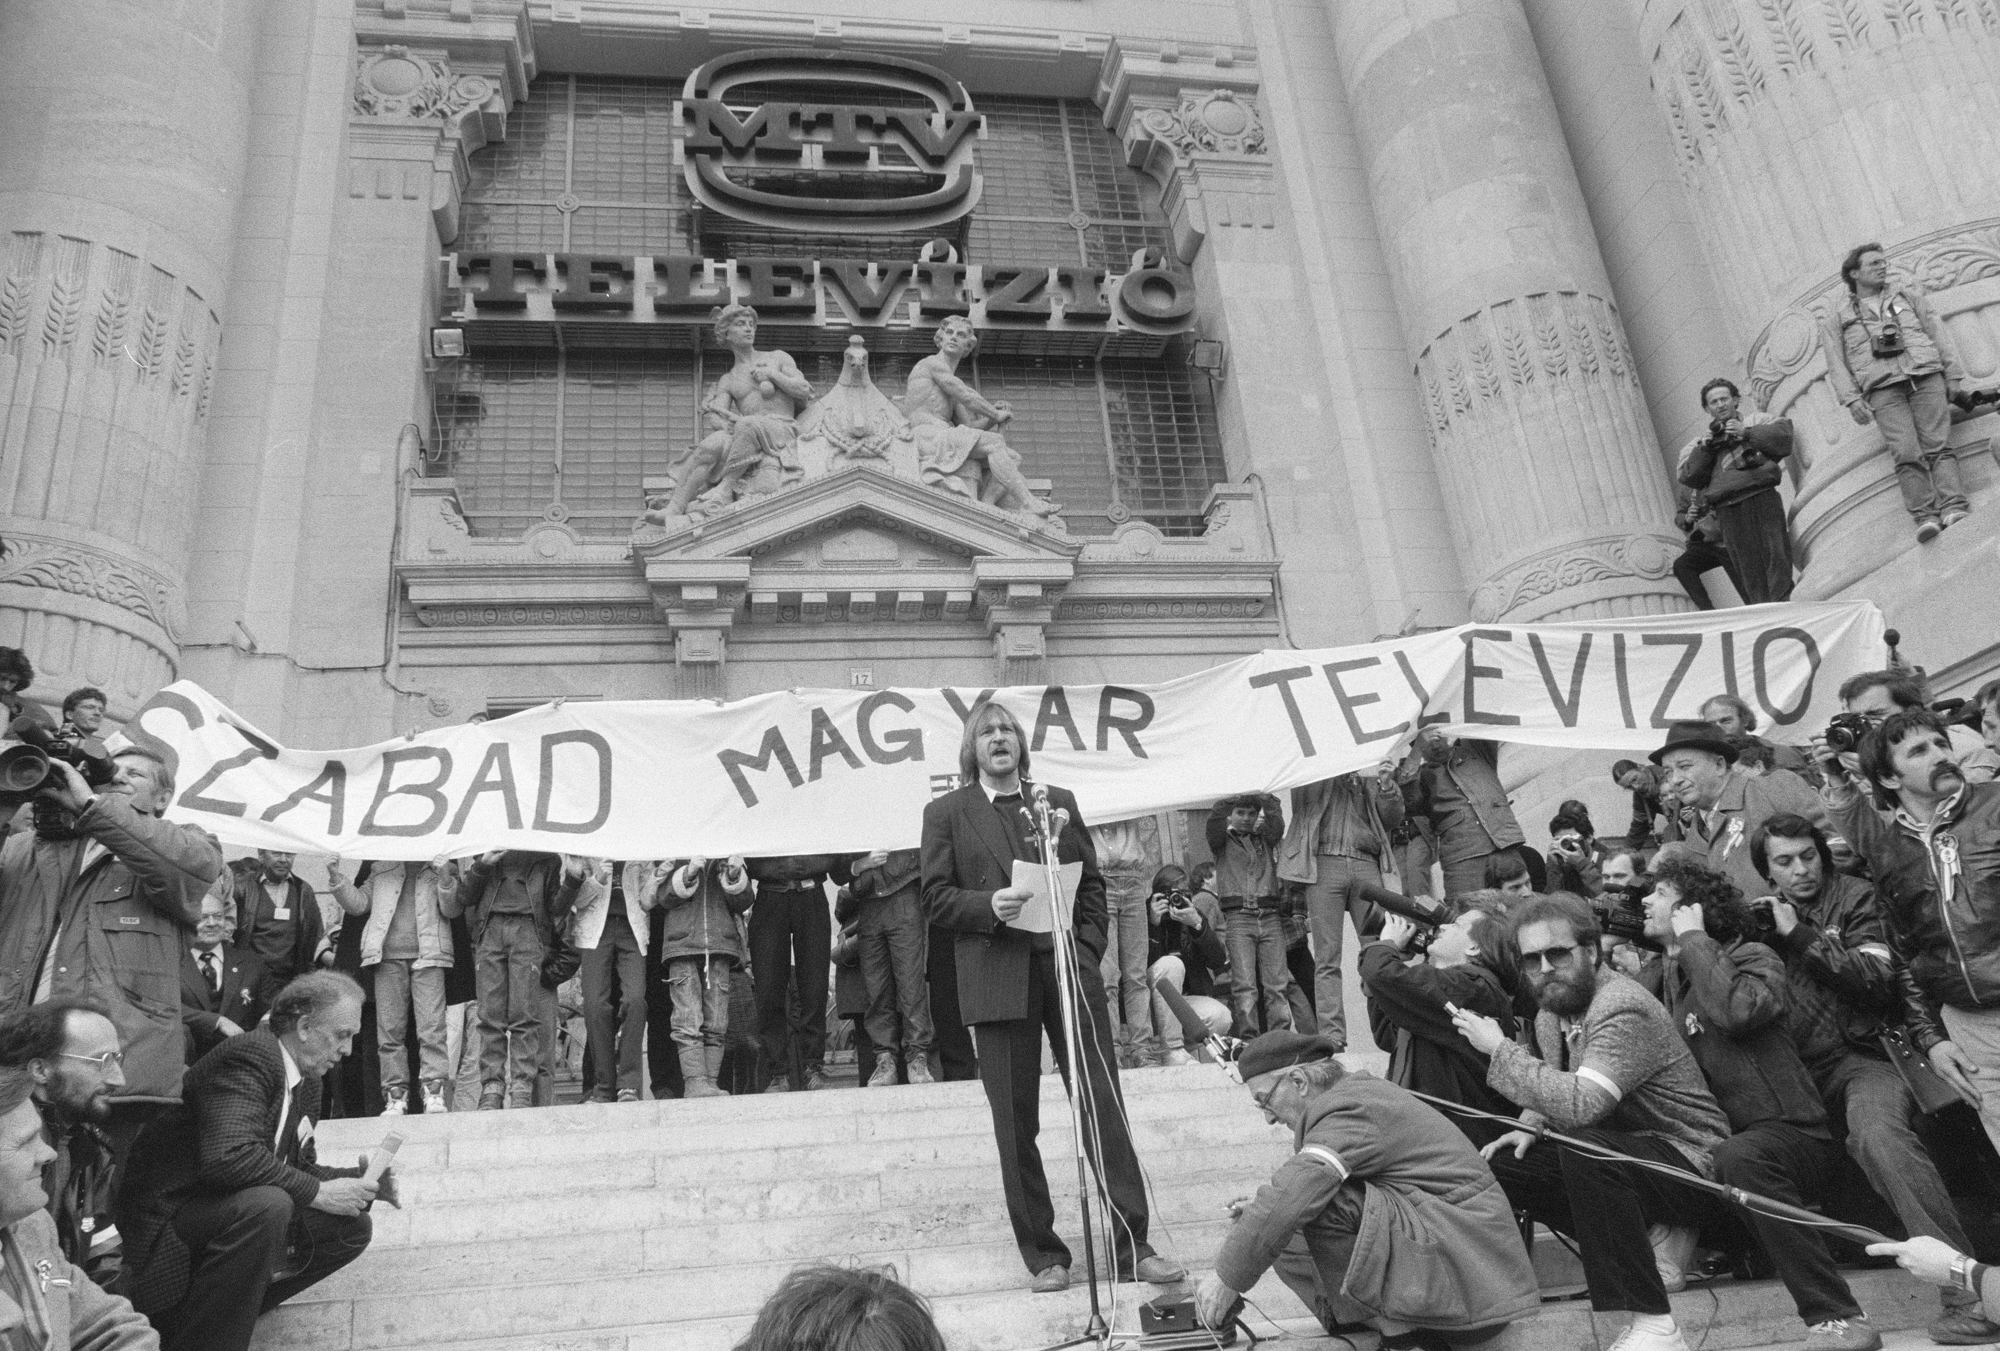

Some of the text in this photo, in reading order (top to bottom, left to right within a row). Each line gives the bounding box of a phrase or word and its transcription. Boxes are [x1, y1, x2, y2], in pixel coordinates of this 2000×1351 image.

[682, 101, 982, 164] MTV
[456, 240, 1197, 325] TELEVÍZIÓ
[120, 627, 1821, 836] SZABAD MAGYAR TELEVIZIO
